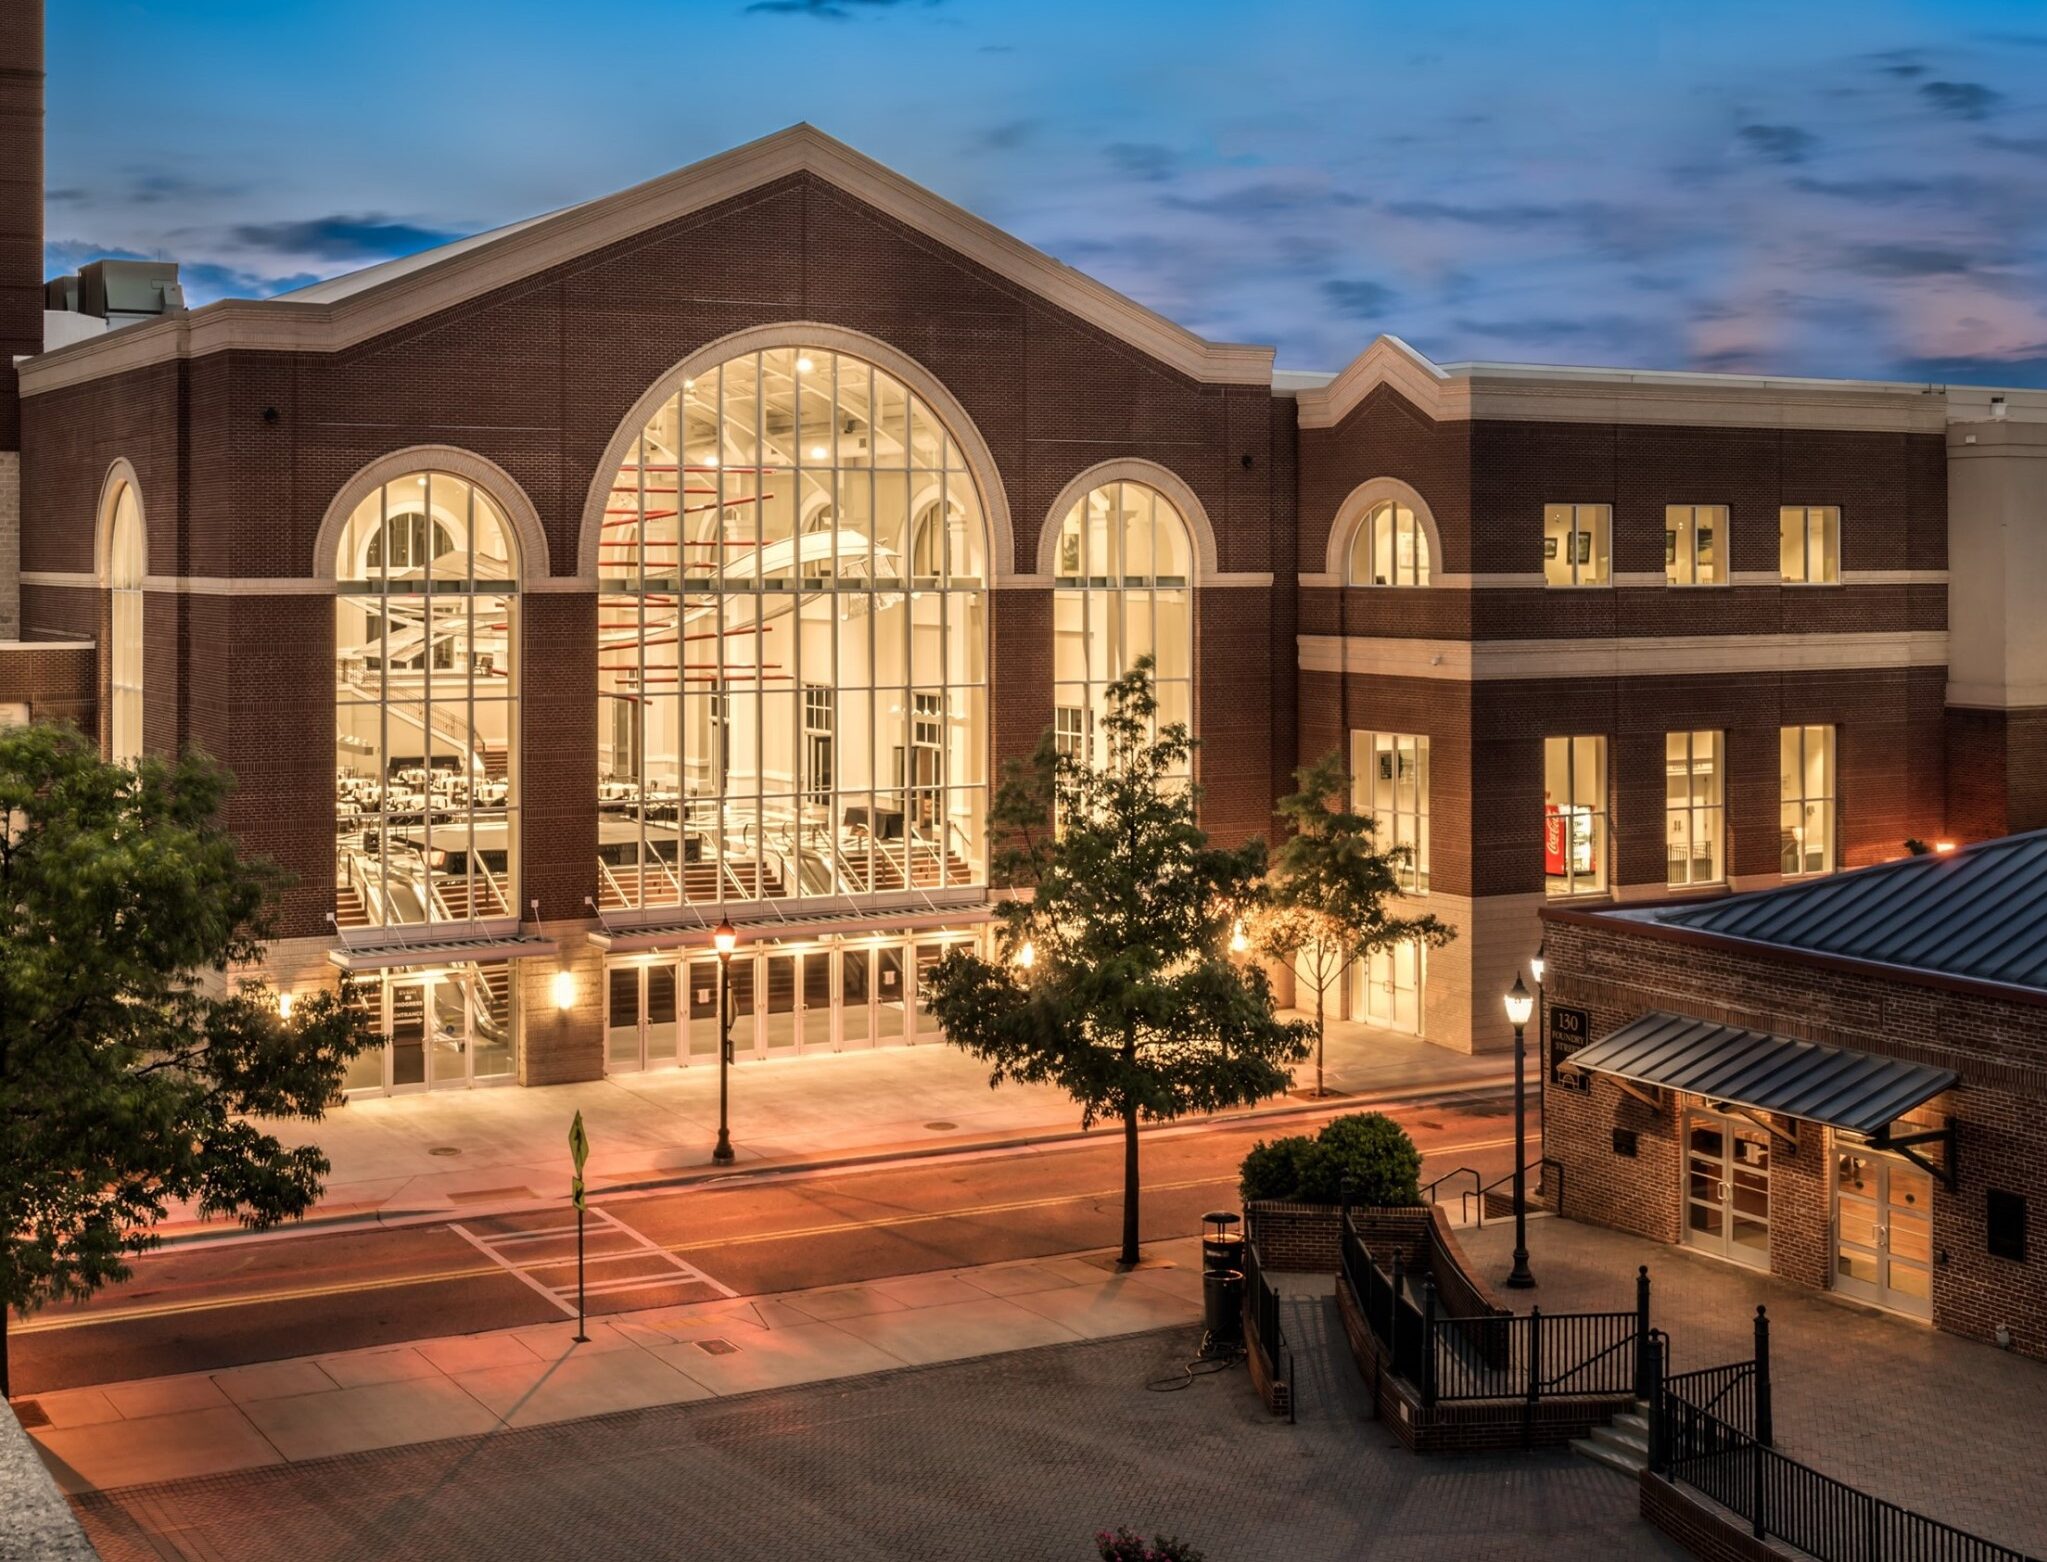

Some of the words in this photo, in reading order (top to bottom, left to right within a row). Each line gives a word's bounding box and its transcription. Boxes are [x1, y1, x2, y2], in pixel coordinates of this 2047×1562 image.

[393, 1000, 423, 1008] PROGRESS
[1558, 1013, 1578, 1031] 130
[1552, 1030, 1585, 1045] FOUNDRY
